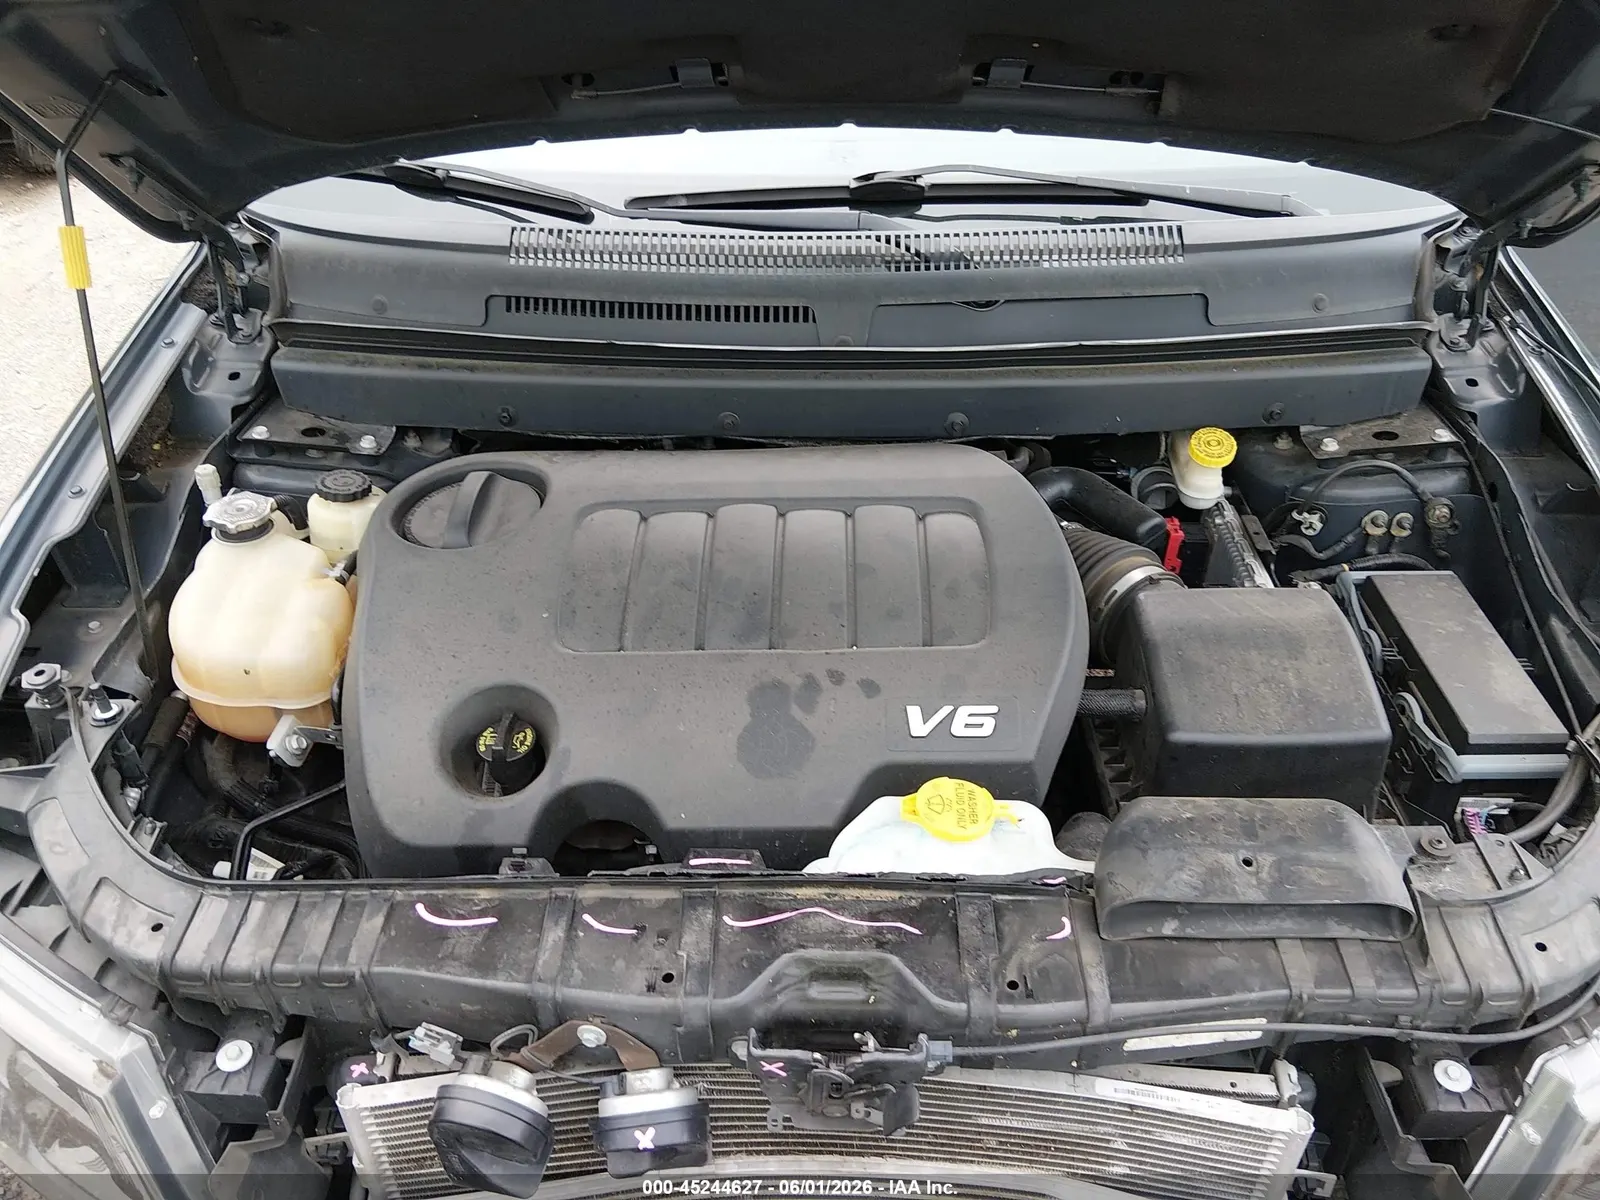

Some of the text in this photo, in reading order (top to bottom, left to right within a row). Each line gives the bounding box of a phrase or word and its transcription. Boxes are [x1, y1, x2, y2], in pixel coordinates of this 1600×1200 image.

[905, 705, 1000, 738] V6
[954, 782, 968, 830] FLUID ONLY
[967, 789, 979, 825] WASHER
